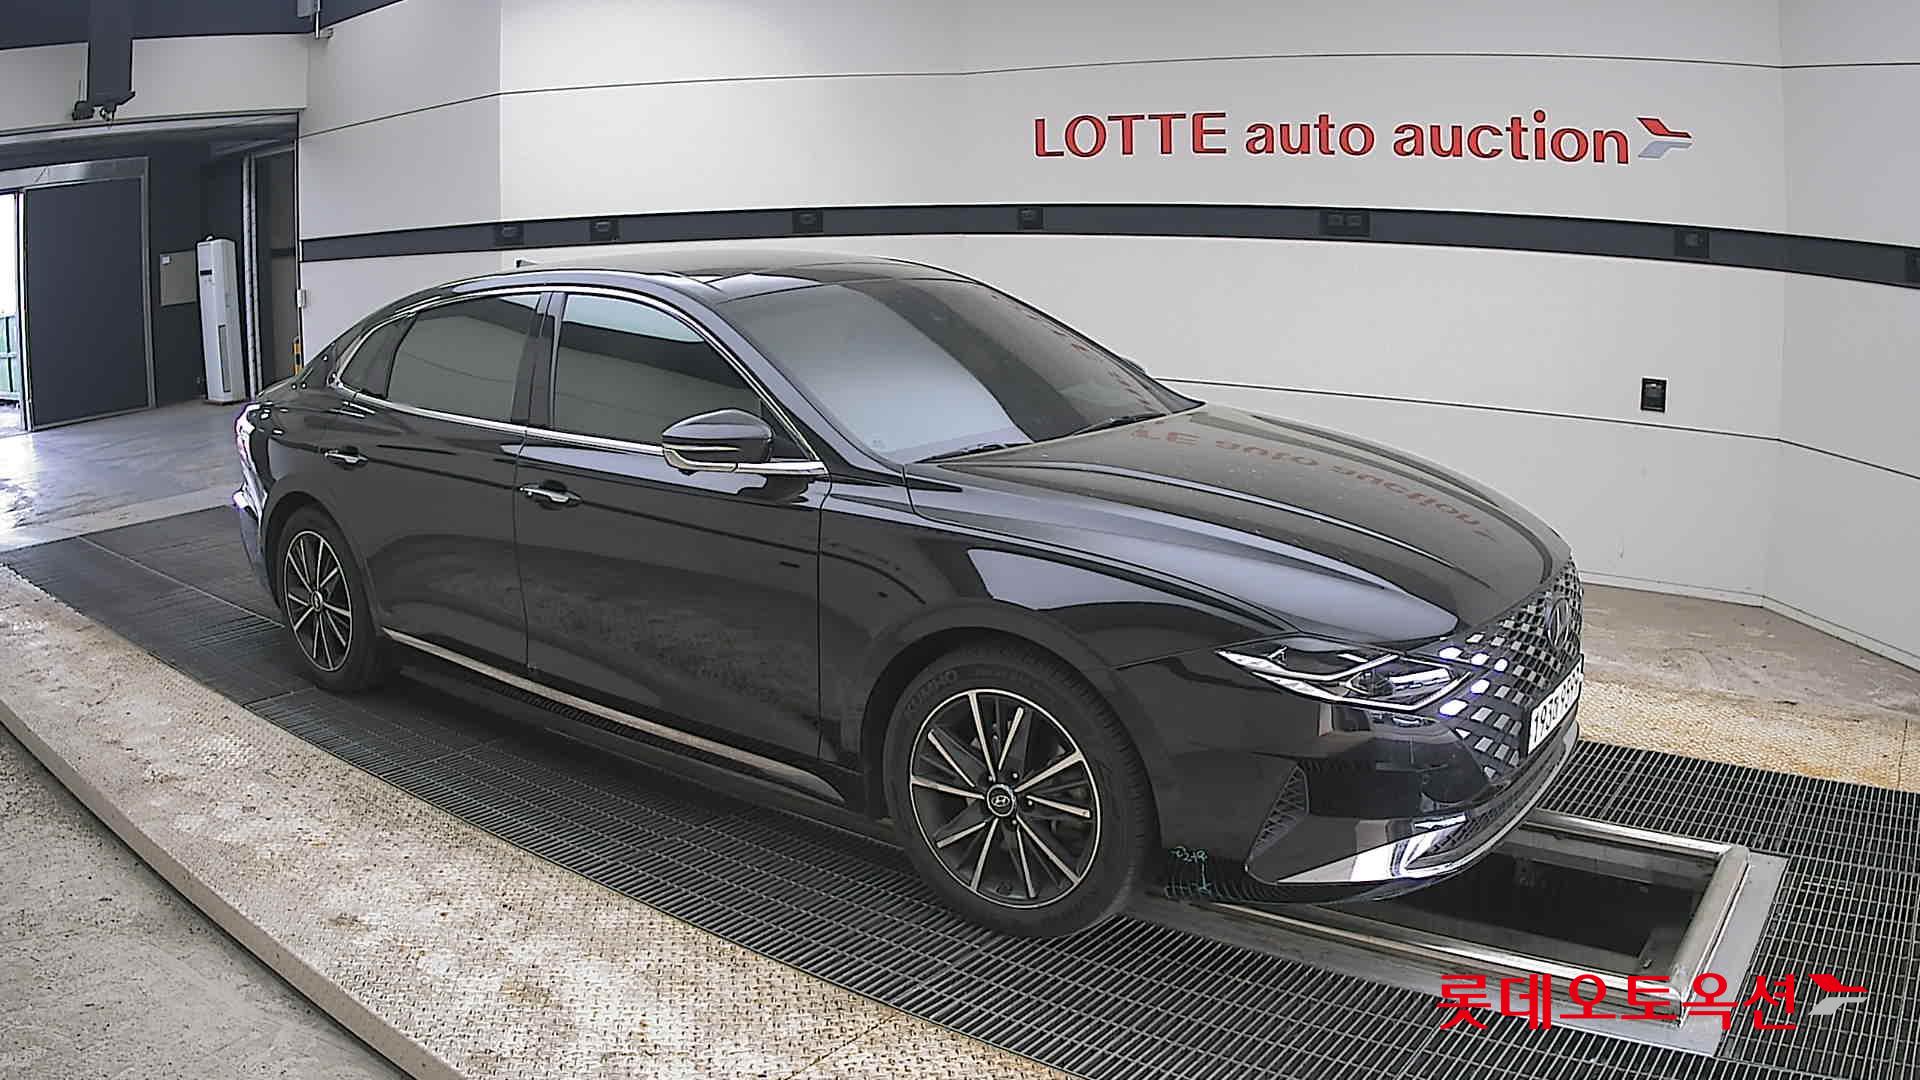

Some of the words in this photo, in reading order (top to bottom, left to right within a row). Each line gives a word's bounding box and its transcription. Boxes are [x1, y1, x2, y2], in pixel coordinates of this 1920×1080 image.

[1033, 112, 1227, 158] LOTTE
[1245, 113, 1376, 157] auto
[1392, 110, 1631, 165] auction
